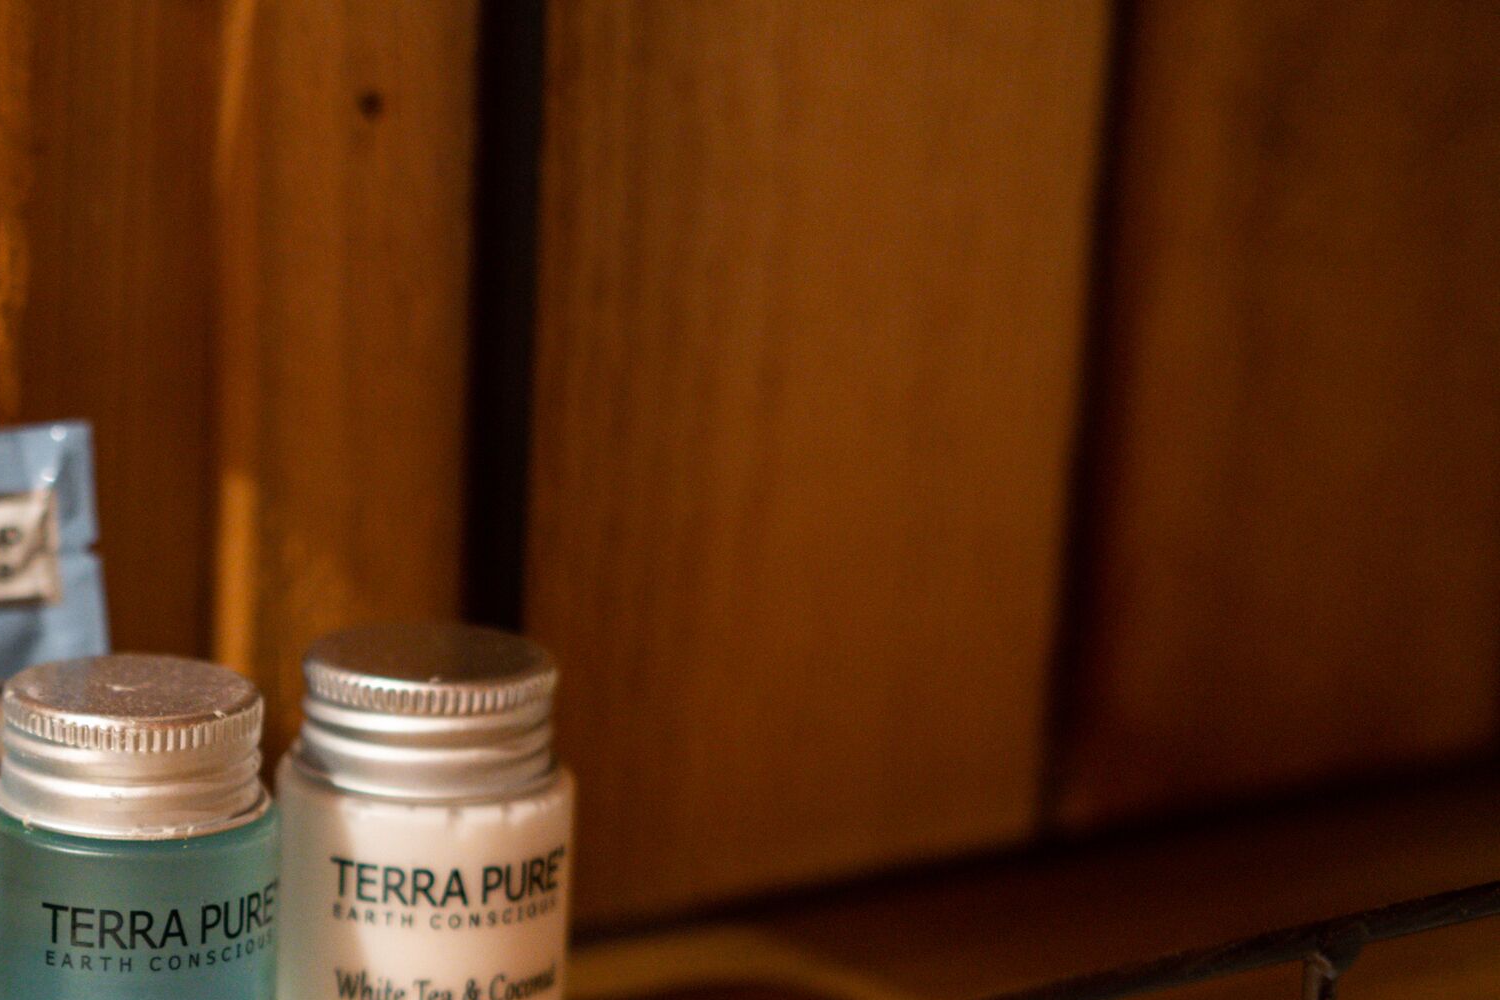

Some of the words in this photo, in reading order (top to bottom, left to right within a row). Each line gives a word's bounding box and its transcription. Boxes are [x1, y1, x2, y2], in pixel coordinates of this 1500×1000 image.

[330, 856, 468, 907] TERRA
[42, 902, 188, 950] TERRA
[332, 904, 414, 926] EARTH
[46, 950, 132, 972] EARTH
